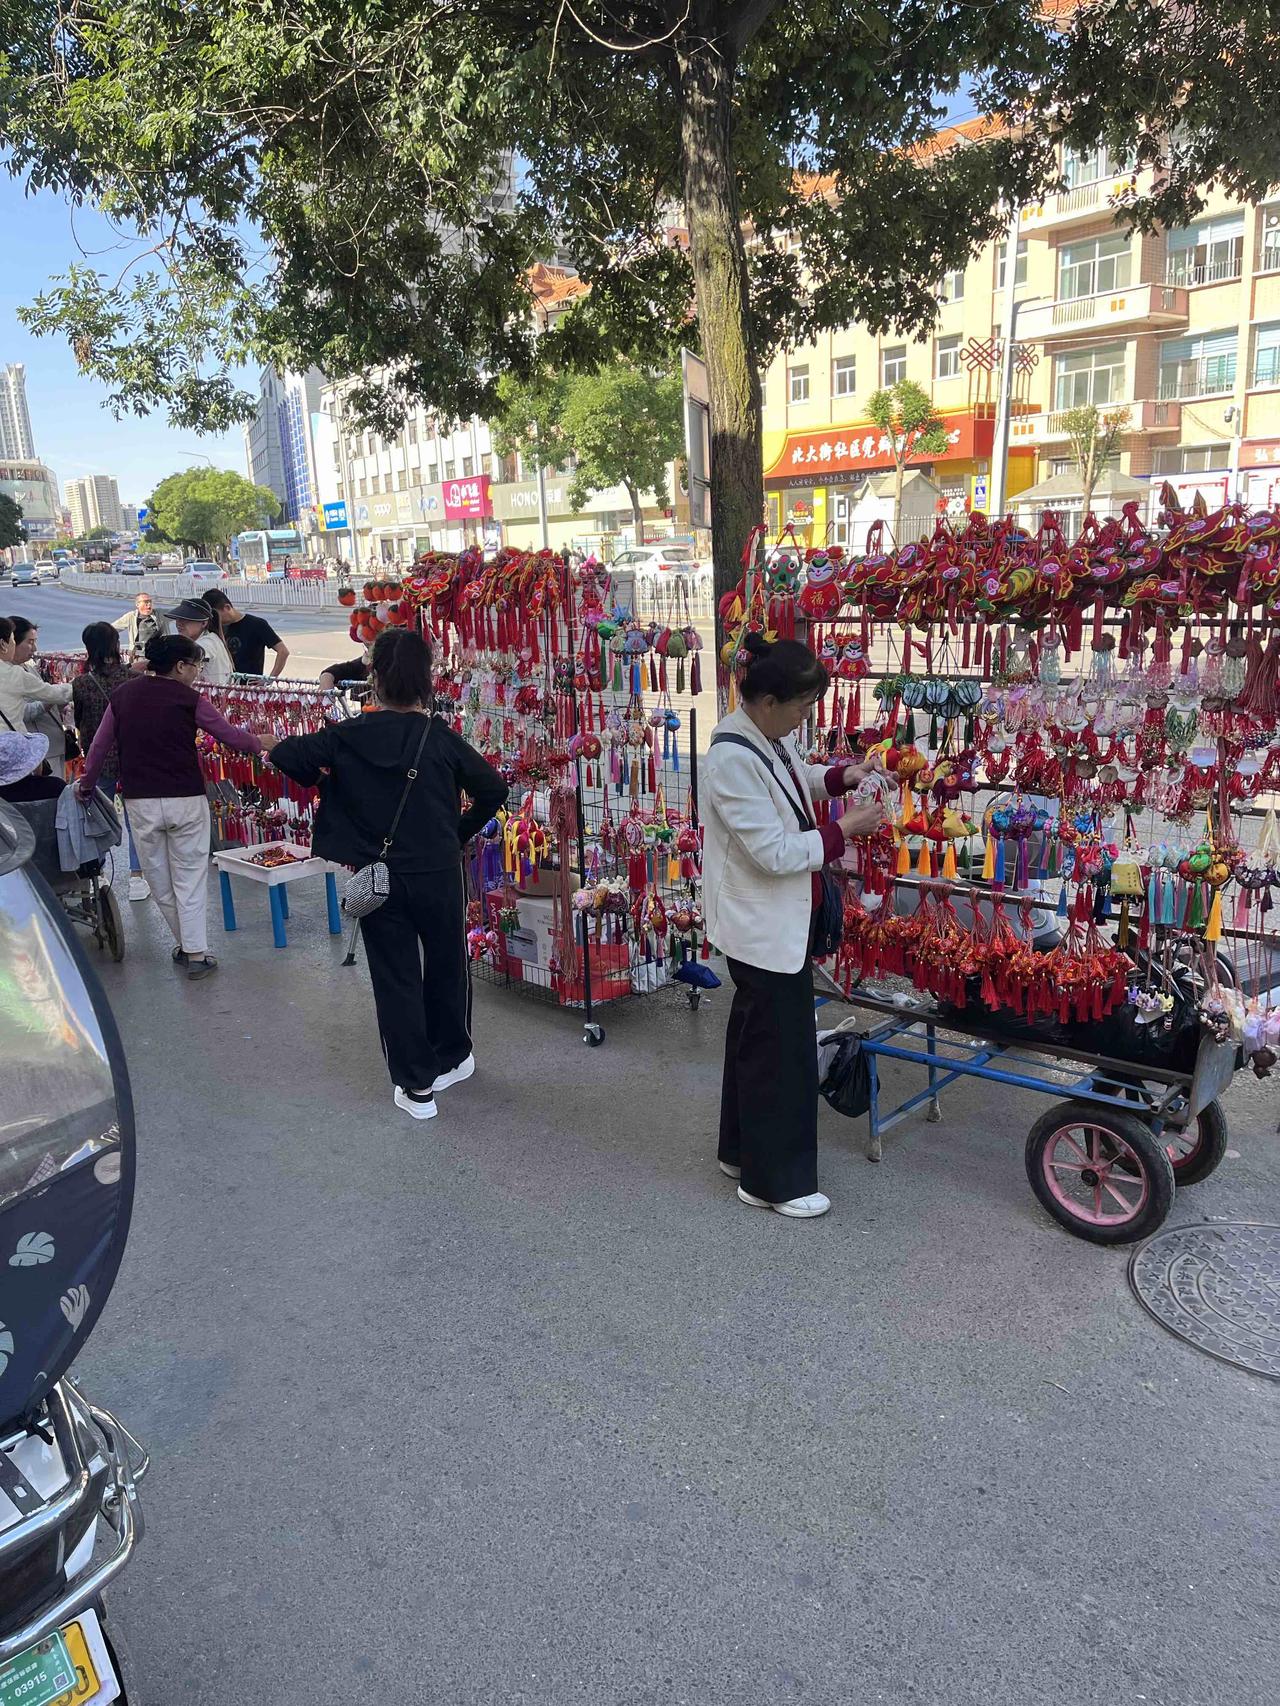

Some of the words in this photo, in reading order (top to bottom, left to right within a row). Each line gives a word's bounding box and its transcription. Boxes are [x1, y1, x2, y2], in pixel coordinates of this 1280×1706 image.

[791, 429, 961, 465] 北大街社区党群服心
[510, 490, 539, 508] HONO
[14, 1671, 47, 1697] 03915
